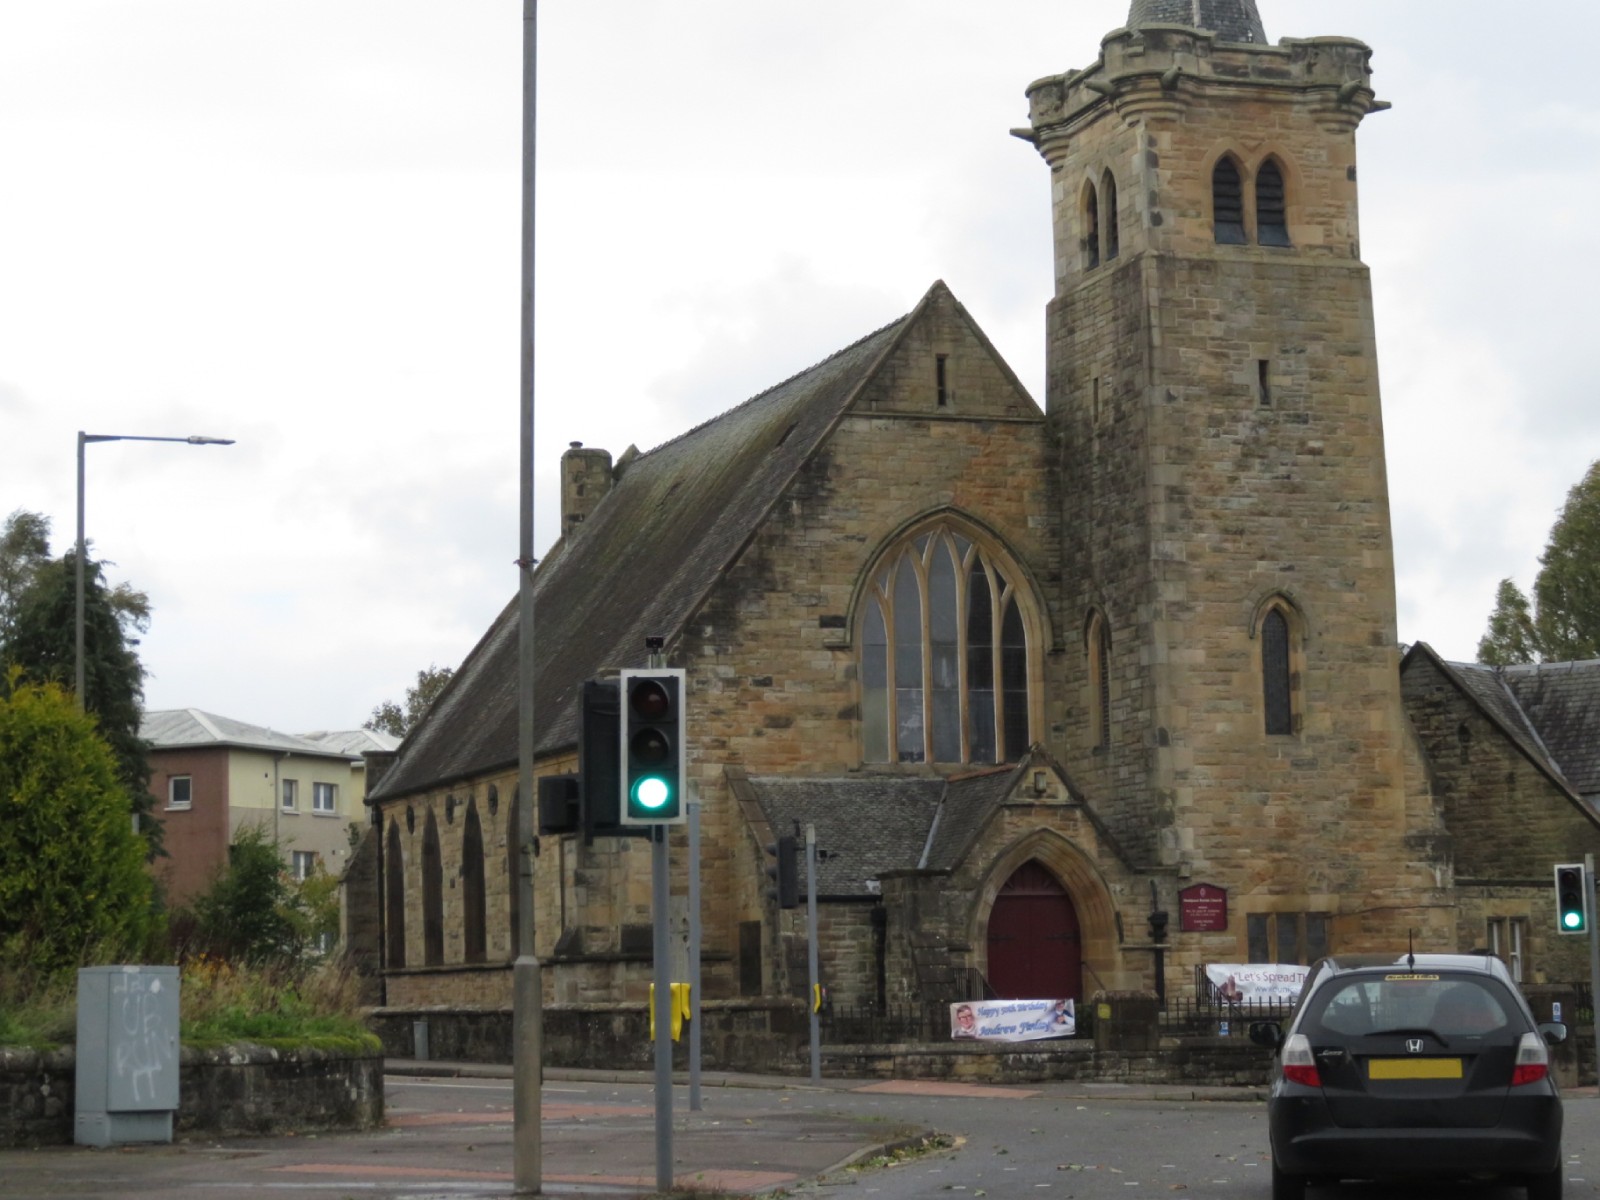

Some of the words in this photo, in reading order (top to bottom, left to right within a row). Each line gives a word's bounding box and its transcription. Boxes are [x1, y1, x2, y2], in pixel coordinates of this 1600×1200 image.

[1263, 972, 1296, 983] Spread
[978, 1006, 999, 1018] Happy
[1017, 1001, 1047, 1012] Birthday
[979, 1024, 1017, 1036] Andrew
